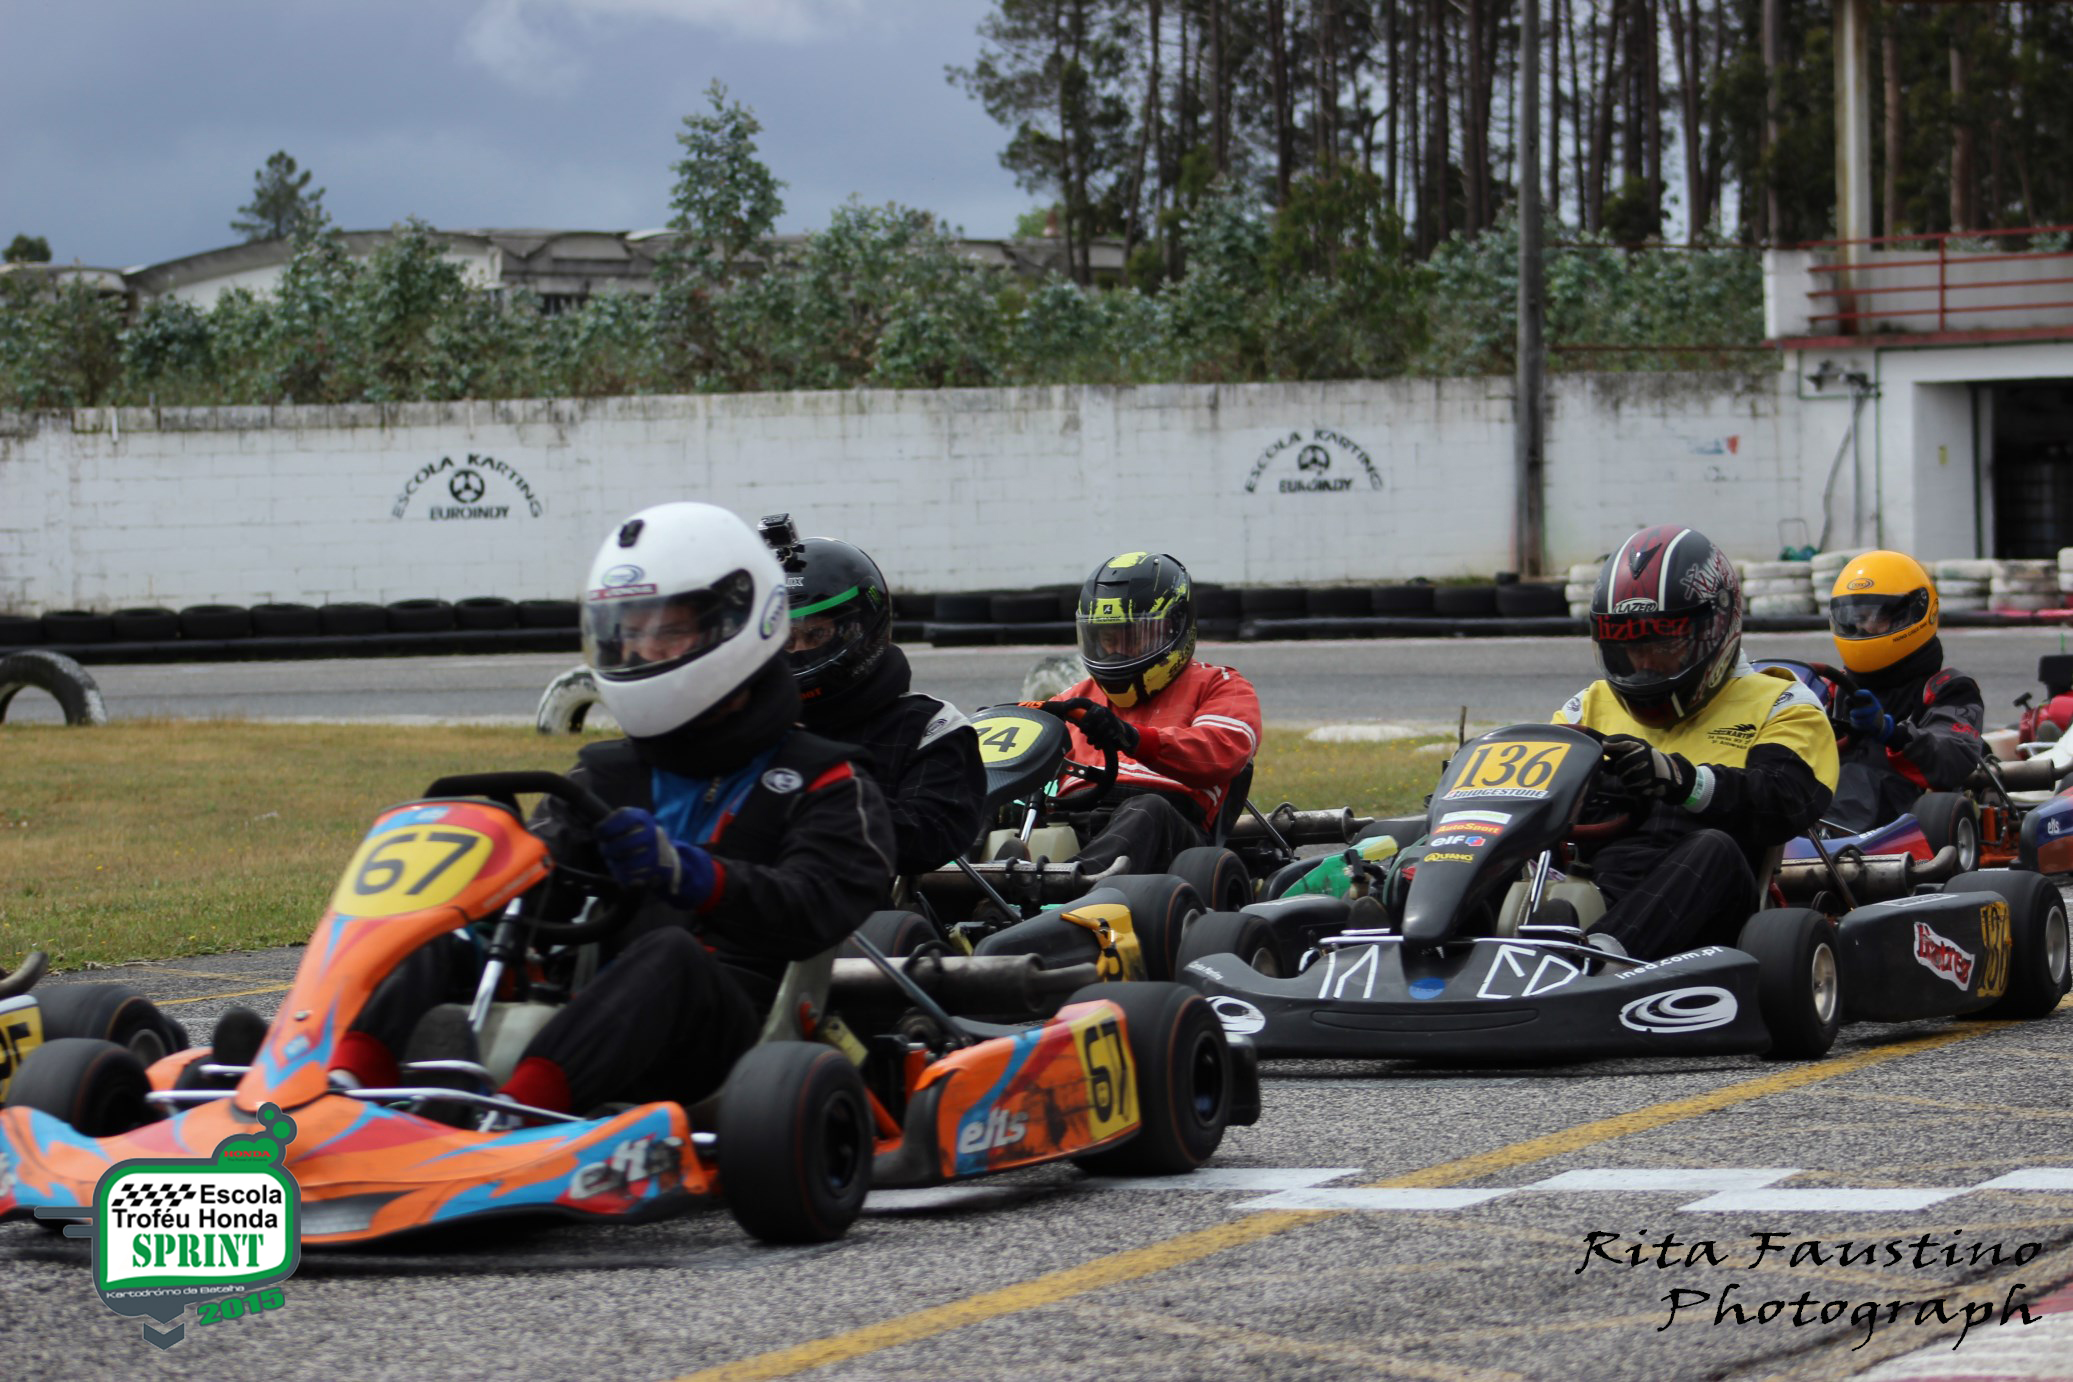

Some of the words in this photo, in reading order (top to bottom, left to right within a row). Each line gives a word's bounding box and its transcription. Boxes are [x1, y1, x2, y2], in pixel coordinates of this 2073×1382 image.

[1245, 431, 1302, 493] ESCOLA
[1314, 429, 1384, 492] KARTING
[392, 456, 454, 519] ESCOLA
[467, 453, 544, 519] KARTING
[430, 505, 509, 521] EUROINDY
[1455, 744, 1562, 789] 136
[1444, 788, 1549, 799] BRIDGESTONE
[1431, 835, 1465, 848] elf
[1436, 823, 1501, 834] AutoSport
[354, 832, 480, 896] 67
[1084, 1017, 1128, 1123] 67
